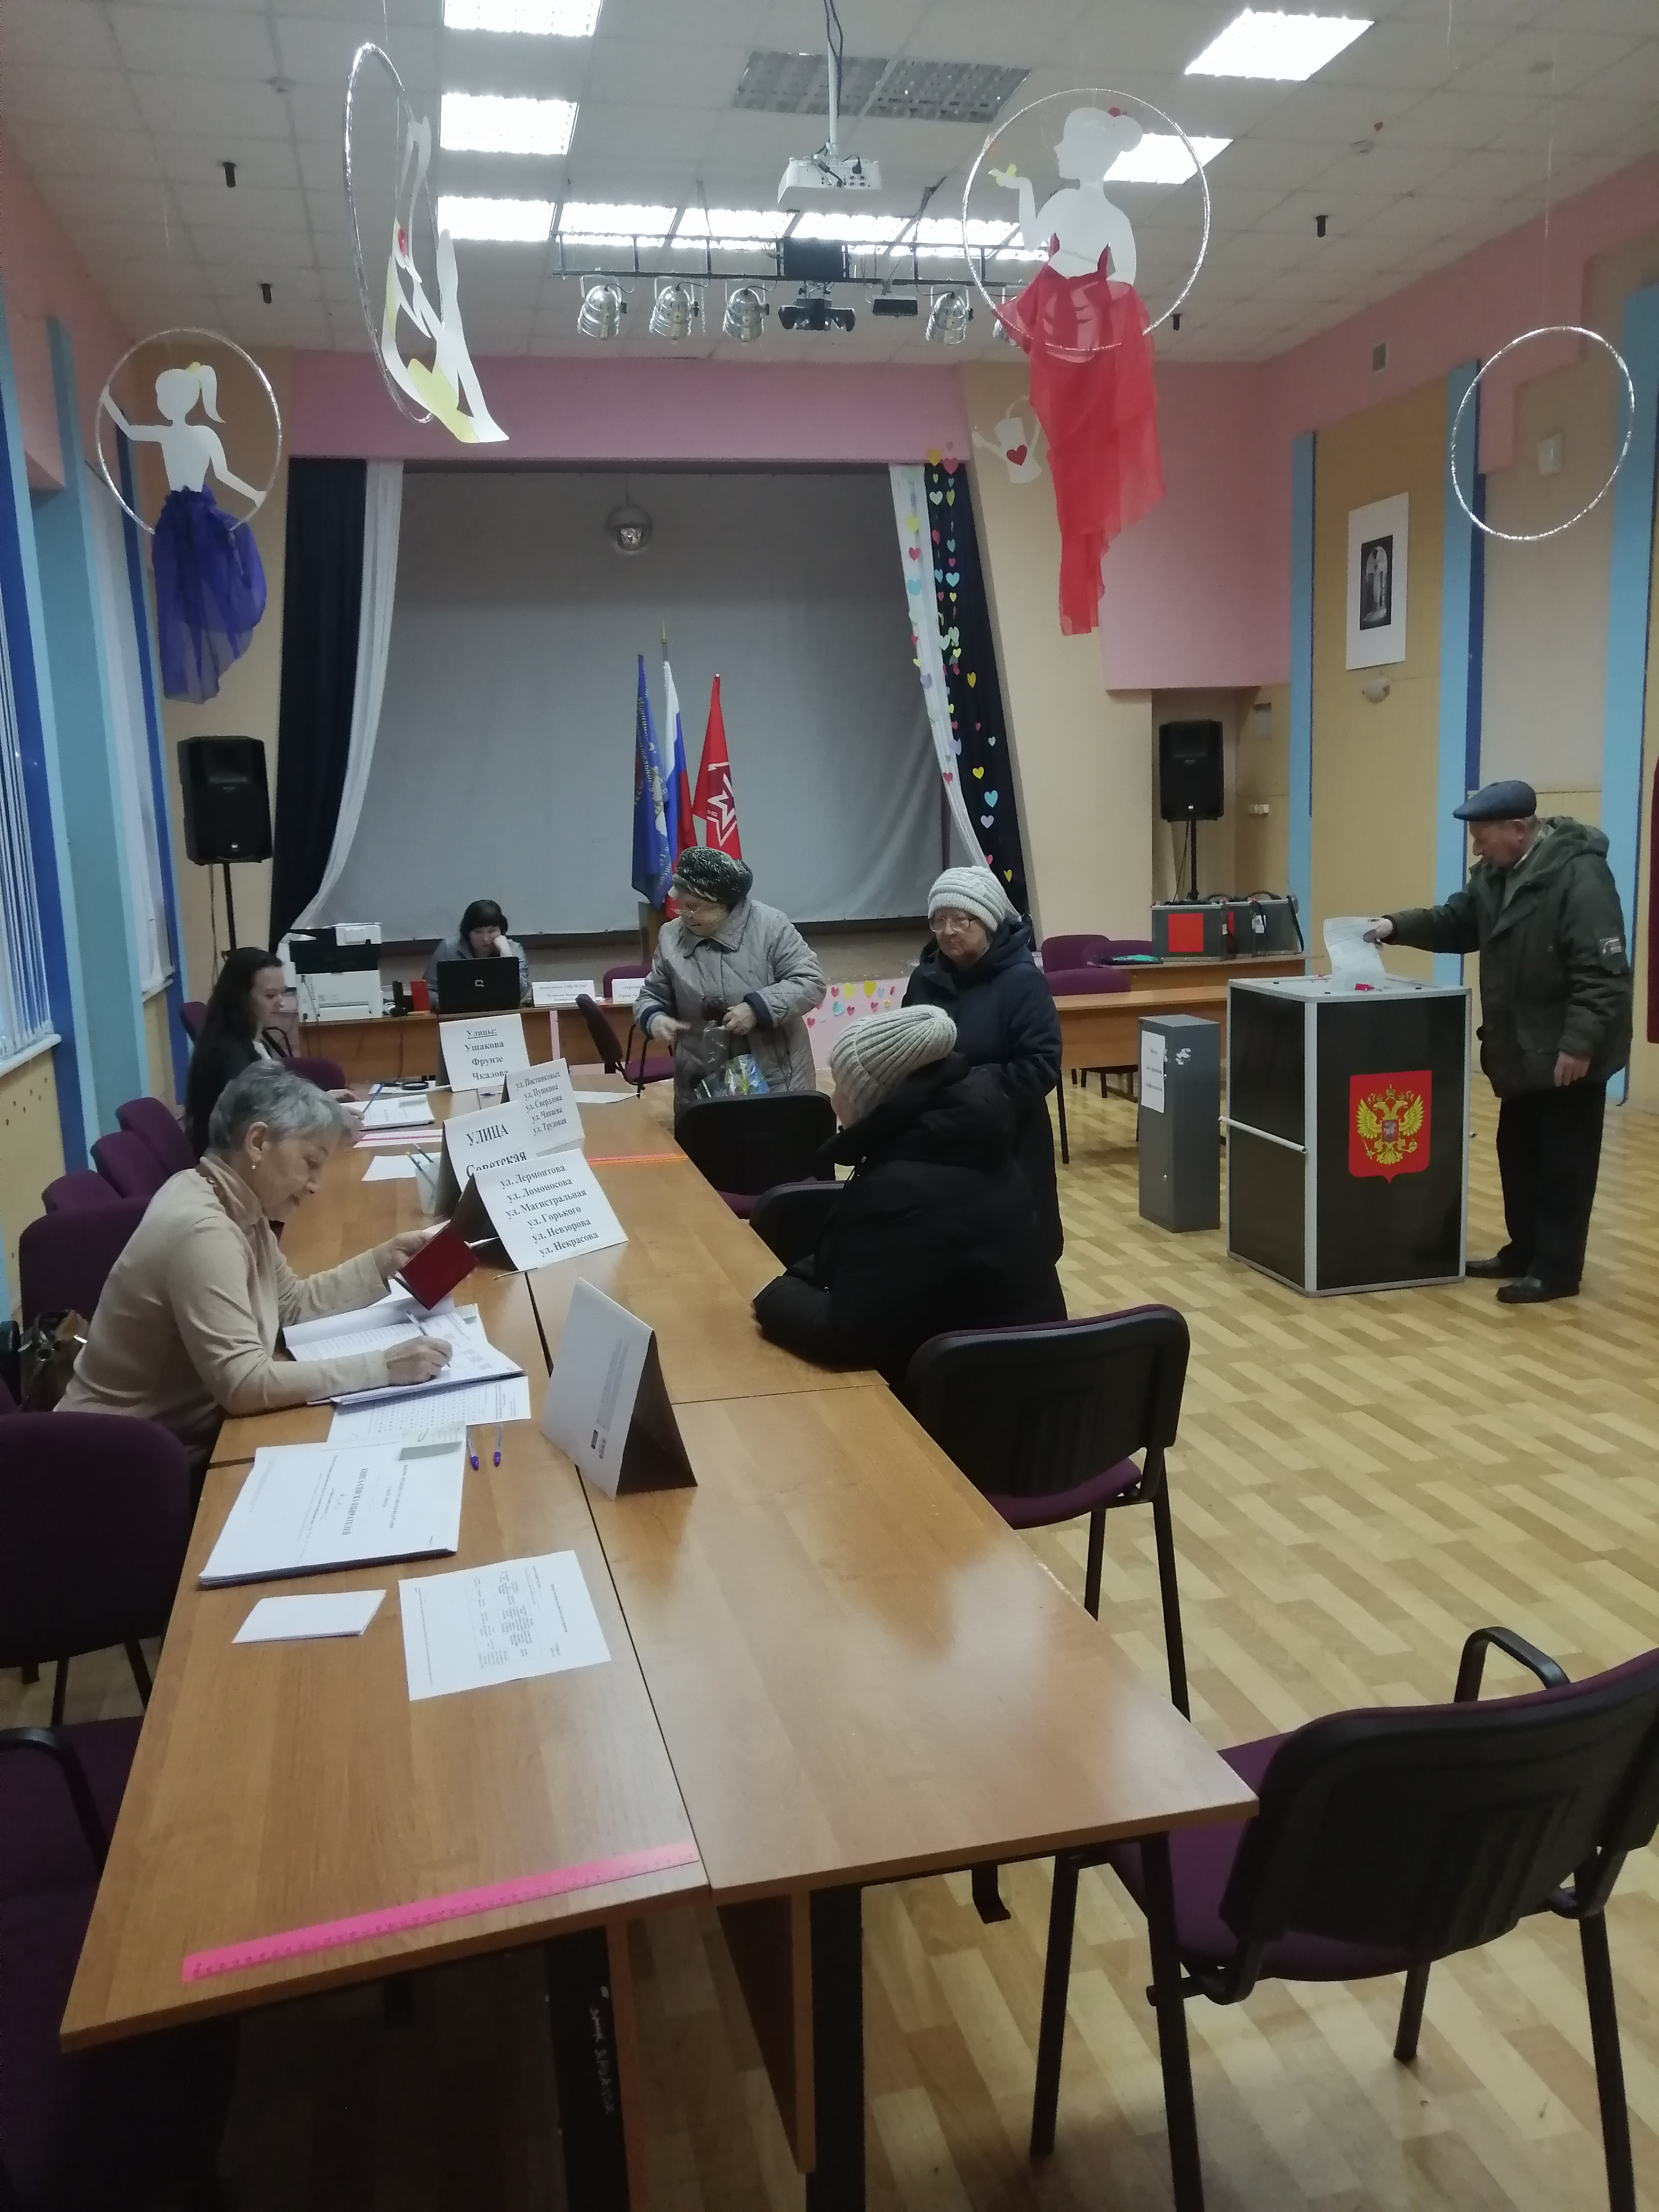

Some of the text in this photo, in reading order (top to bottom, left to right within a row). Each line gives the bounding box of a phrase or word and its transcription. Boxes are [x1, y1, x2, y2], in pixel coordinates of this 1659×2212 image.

[467, 1029, 497, 1038] Улицы:
[465, 1042, 504, 1052] Ушакова
[472, 1057, 503, 1067] Фрунзе
[516, 1082, 524, 1091] ул.
[524, 1084, 558, 1101] ул. Пушкина
[525, 1095, 563, 1113] ул. Свердлова
[532, 1107, 563, 1124] ул. Чапаева
[466, 1124, 509, 1146] УЛИЦА
[533, 1118, 567, 1136] ул. Трудовая
[500, 1166, 566, 1189] ул. Лермонтова
[507, 1178, 573, 1203] ул. Ломоносова
[506, 1190, 587, 1220] ул. Магистральная
[527, 1207, 581, 1229] ул. Горького
[532, 1219, 591, 1244] ул. Невзорова
[539, 1232, 598, 1257] ул. Некрасова
